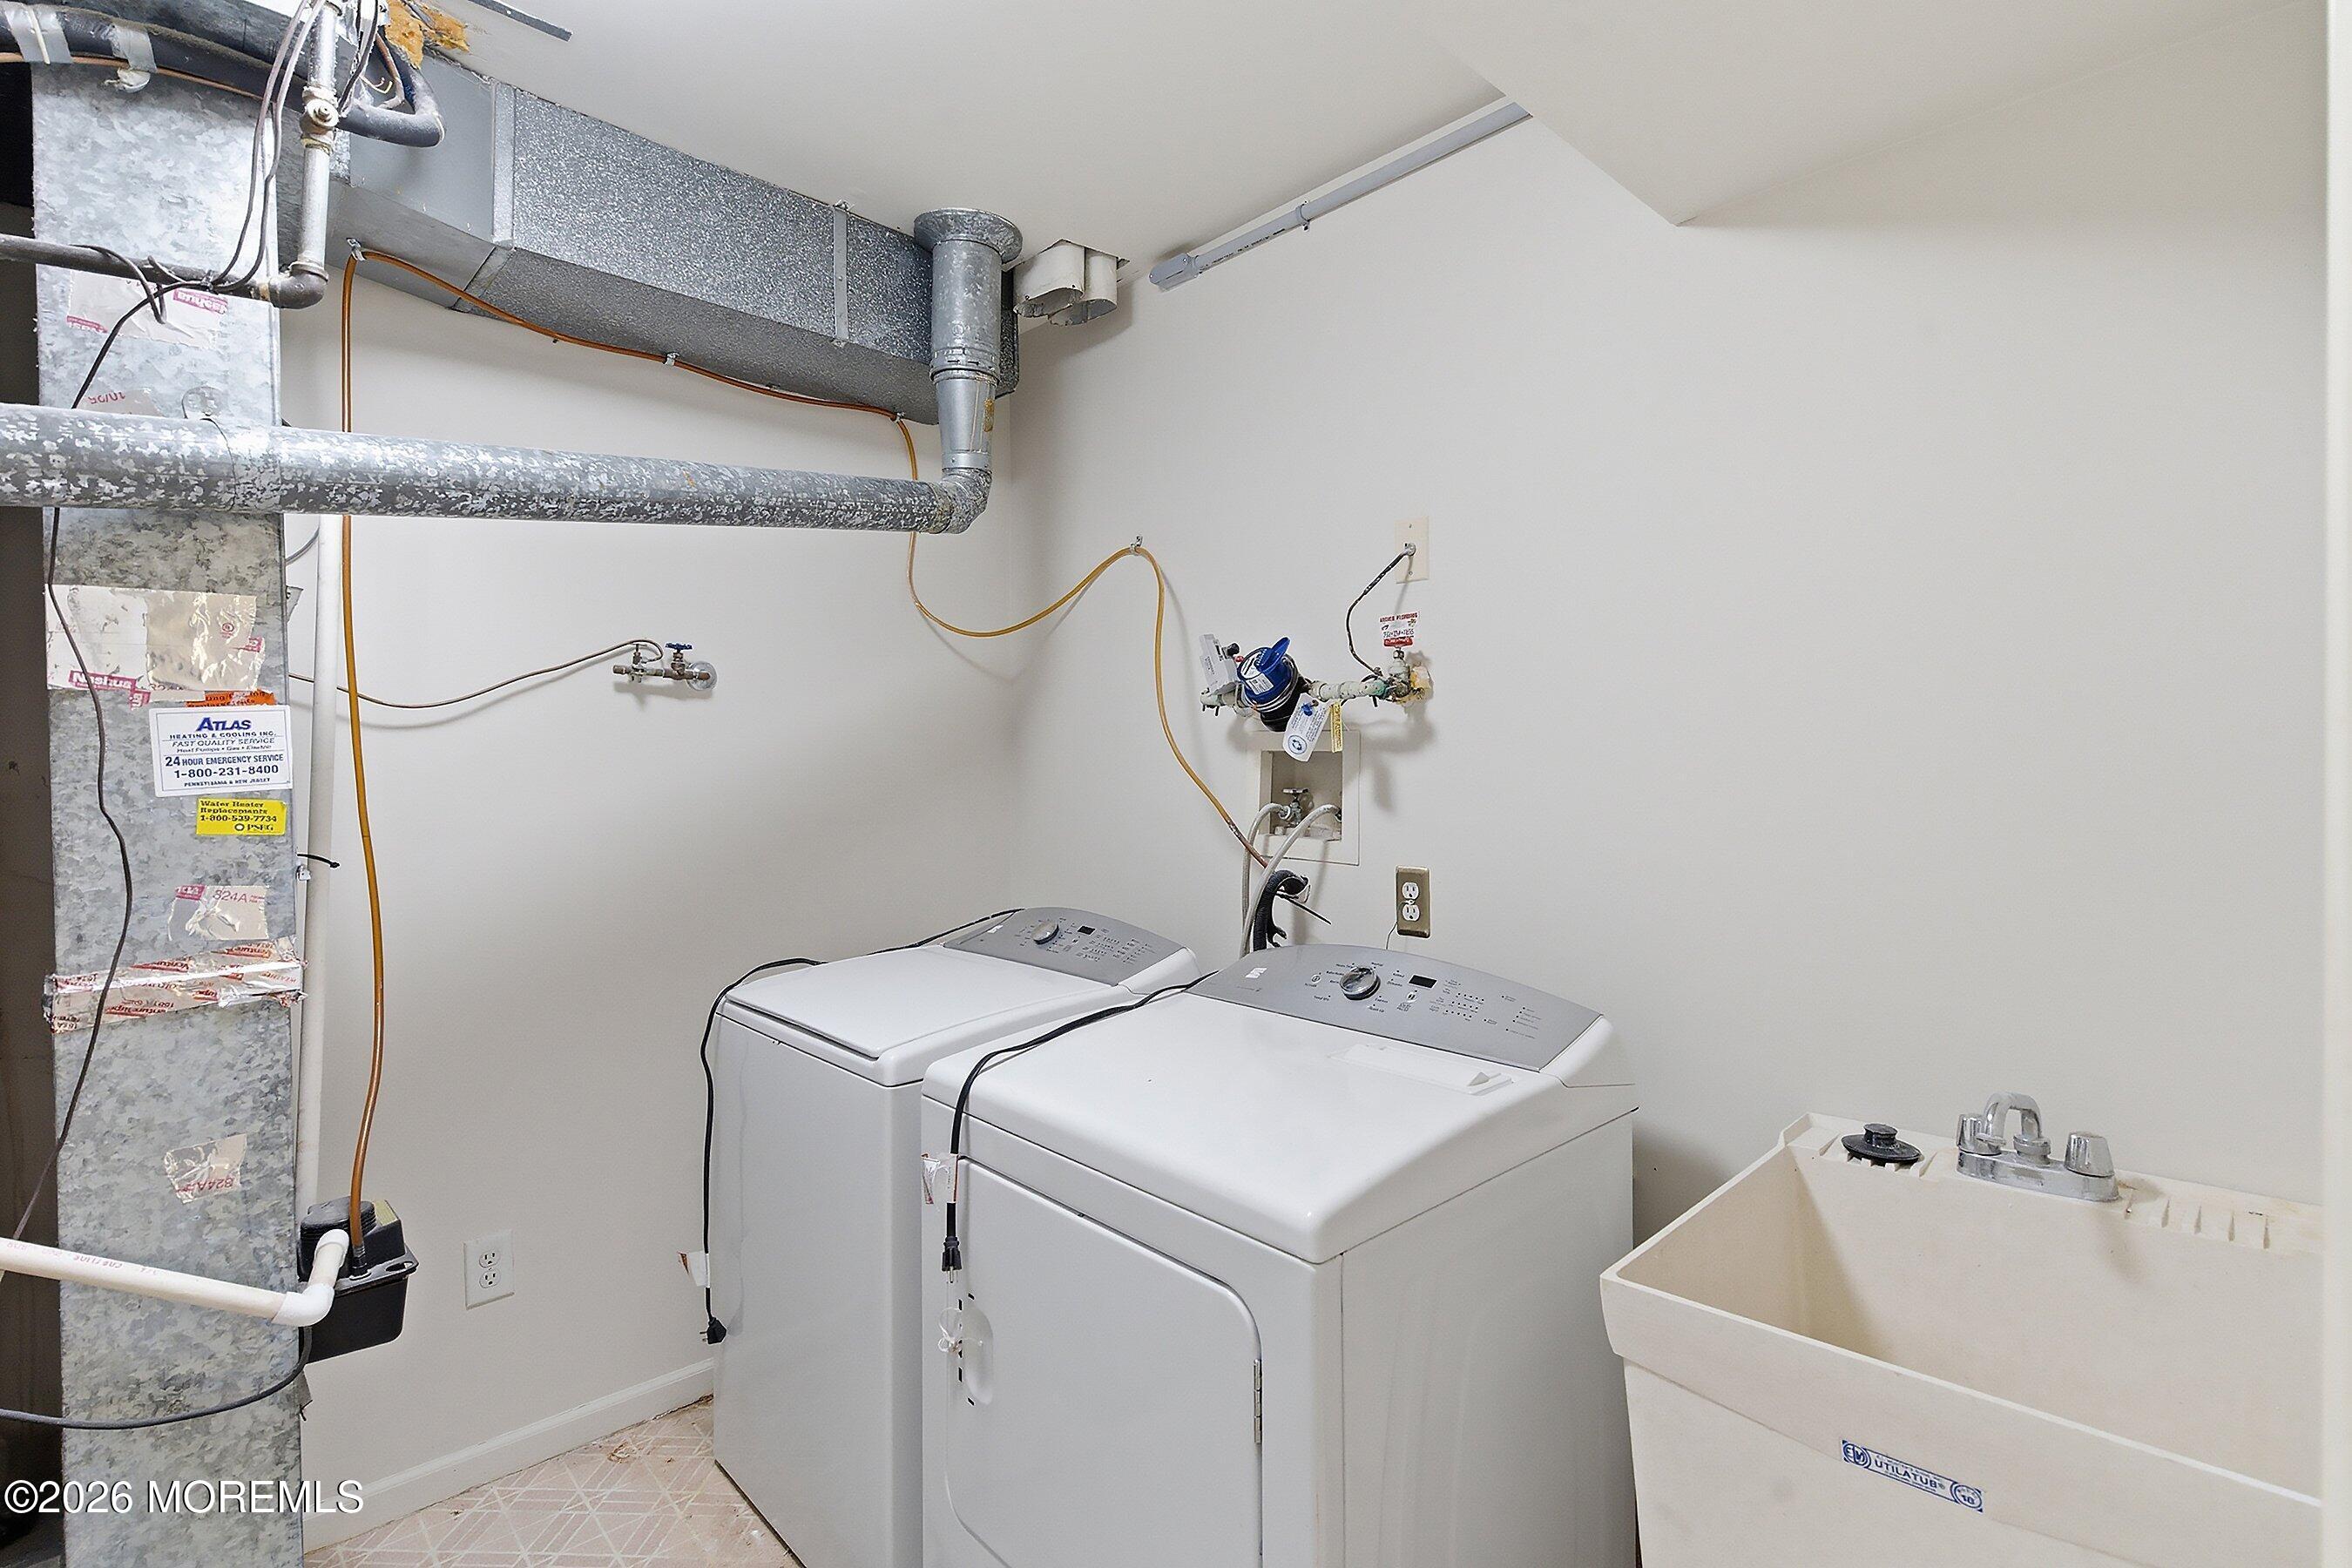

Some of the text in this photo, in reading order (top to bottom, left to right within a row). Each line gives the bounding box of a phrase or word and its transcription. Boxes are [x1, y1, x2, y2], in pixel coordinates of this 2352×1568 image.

[165, 754, 284, 767] 24 HOUR EMERGENCY SERVICE
[174, 764, 279, 779] 1-800-231-8400
[1962, 1494, 1975, 1505] 10
